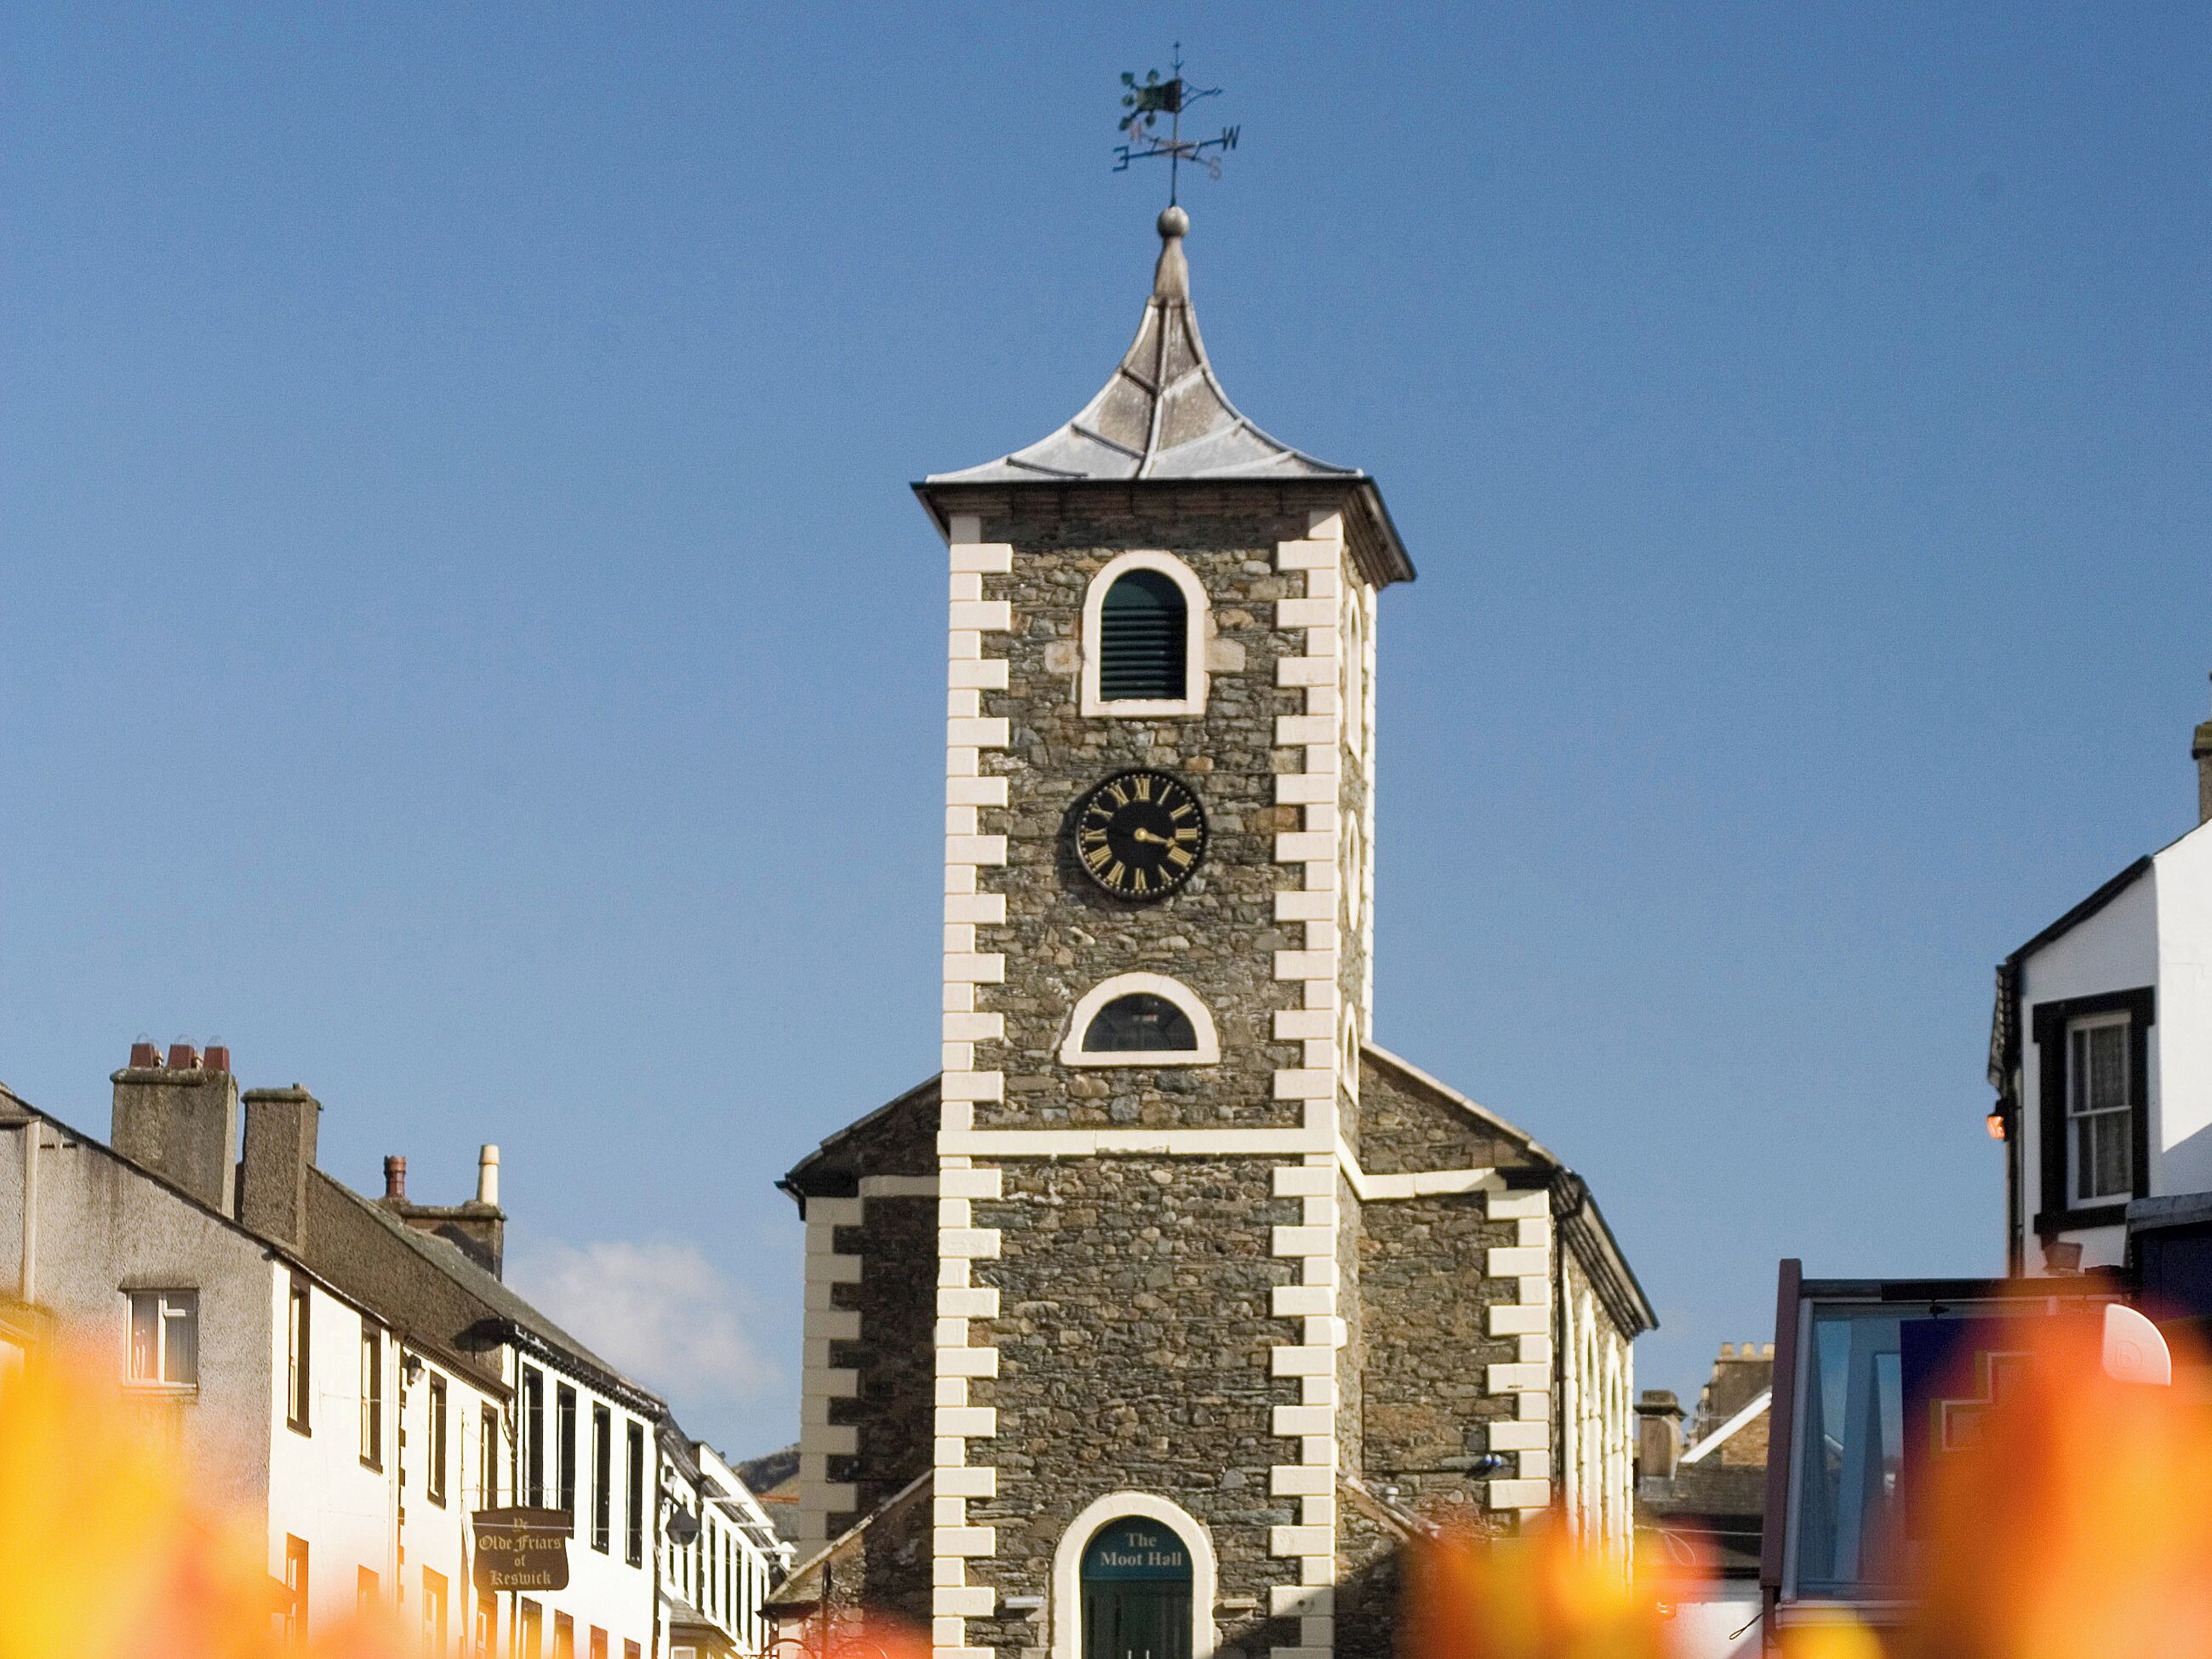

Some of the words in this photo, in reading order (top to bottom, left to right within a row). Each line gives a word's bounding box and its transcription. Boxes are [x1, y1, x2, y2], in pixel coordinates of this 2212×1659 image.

[1222, 124, 1240, 151] W
[478, 1535, 512, 1550] Olde
[512, 1535, 562, 1553] Friars
[1125, 1533, 1157, 1547] The
[514, 1554, 526, 1567] of
[1100, 1552, 1142, 1566] Moot
[1148, 1552, 1182, 1566] Hall
[490, 1570, 552, 1585] Keswick
